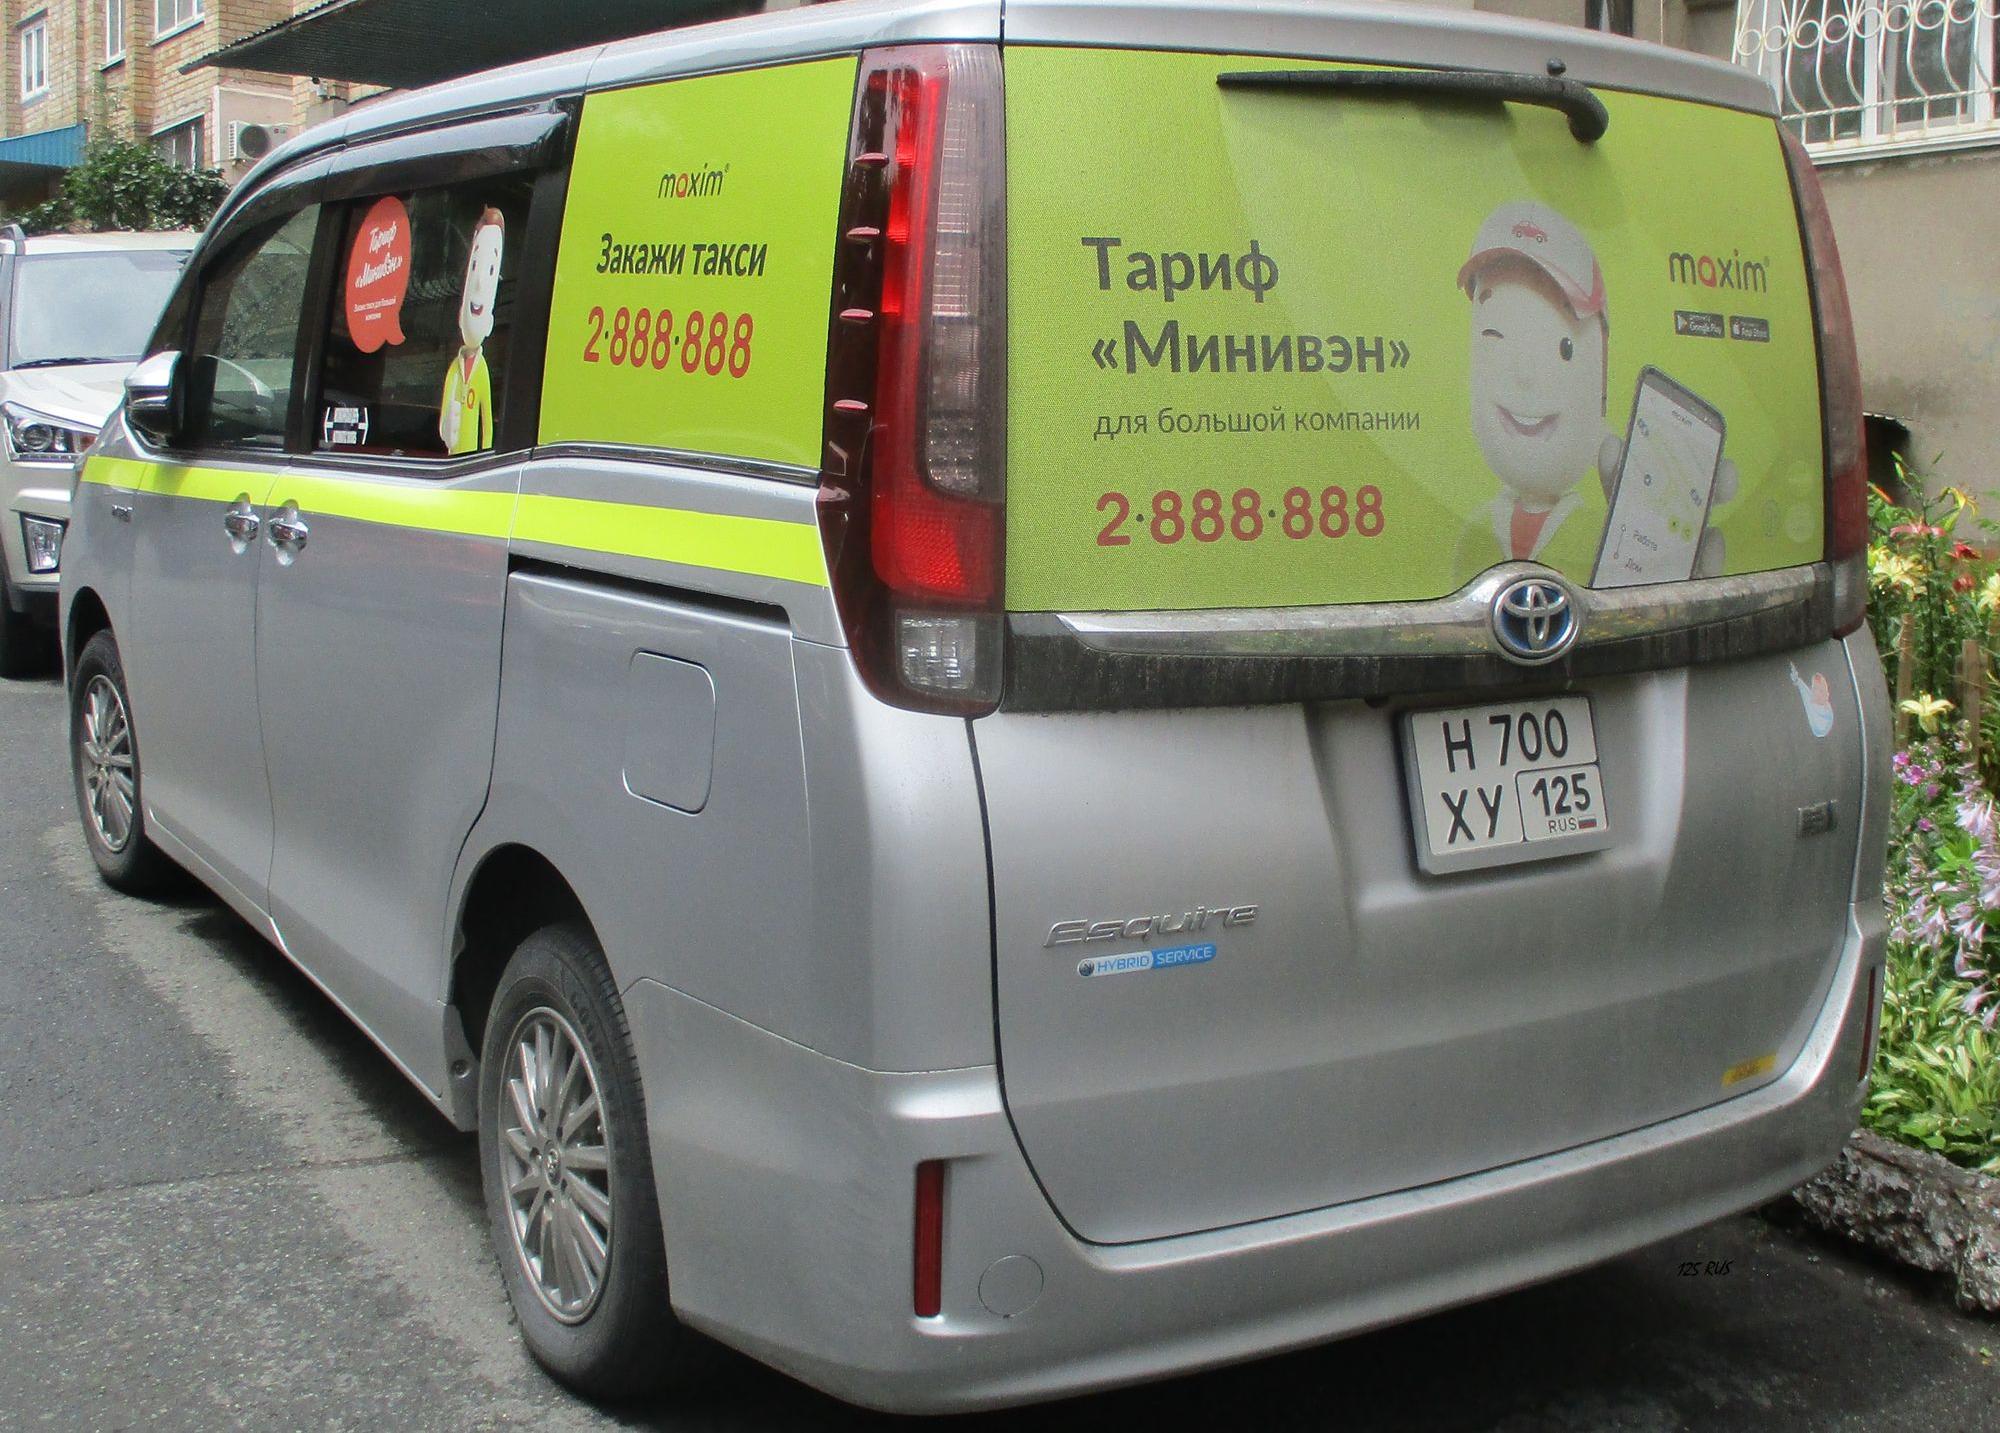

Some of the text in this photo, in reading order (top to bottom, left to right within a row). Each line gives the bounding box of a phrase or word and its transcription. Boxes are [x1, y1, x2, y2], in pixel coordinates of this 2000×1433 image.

[658, 163, 724, 199] maxim
[596, 232, 768, 277] Закажи такси
[1081, 236, 1279, 303] Тариф
[1669, 248, 1767, 293] maxim
[1091, 319, 1411, 374] «Минивэн»
[1093, 406, 1421, 441] для большой компании
[1489, 708, 1569, 767] 700
[1532, 772, 1591, 817] 125
[1549, 817, 1578, 833] RUS
[1097, 945, 1213, 973] HYBRID SERVICE
